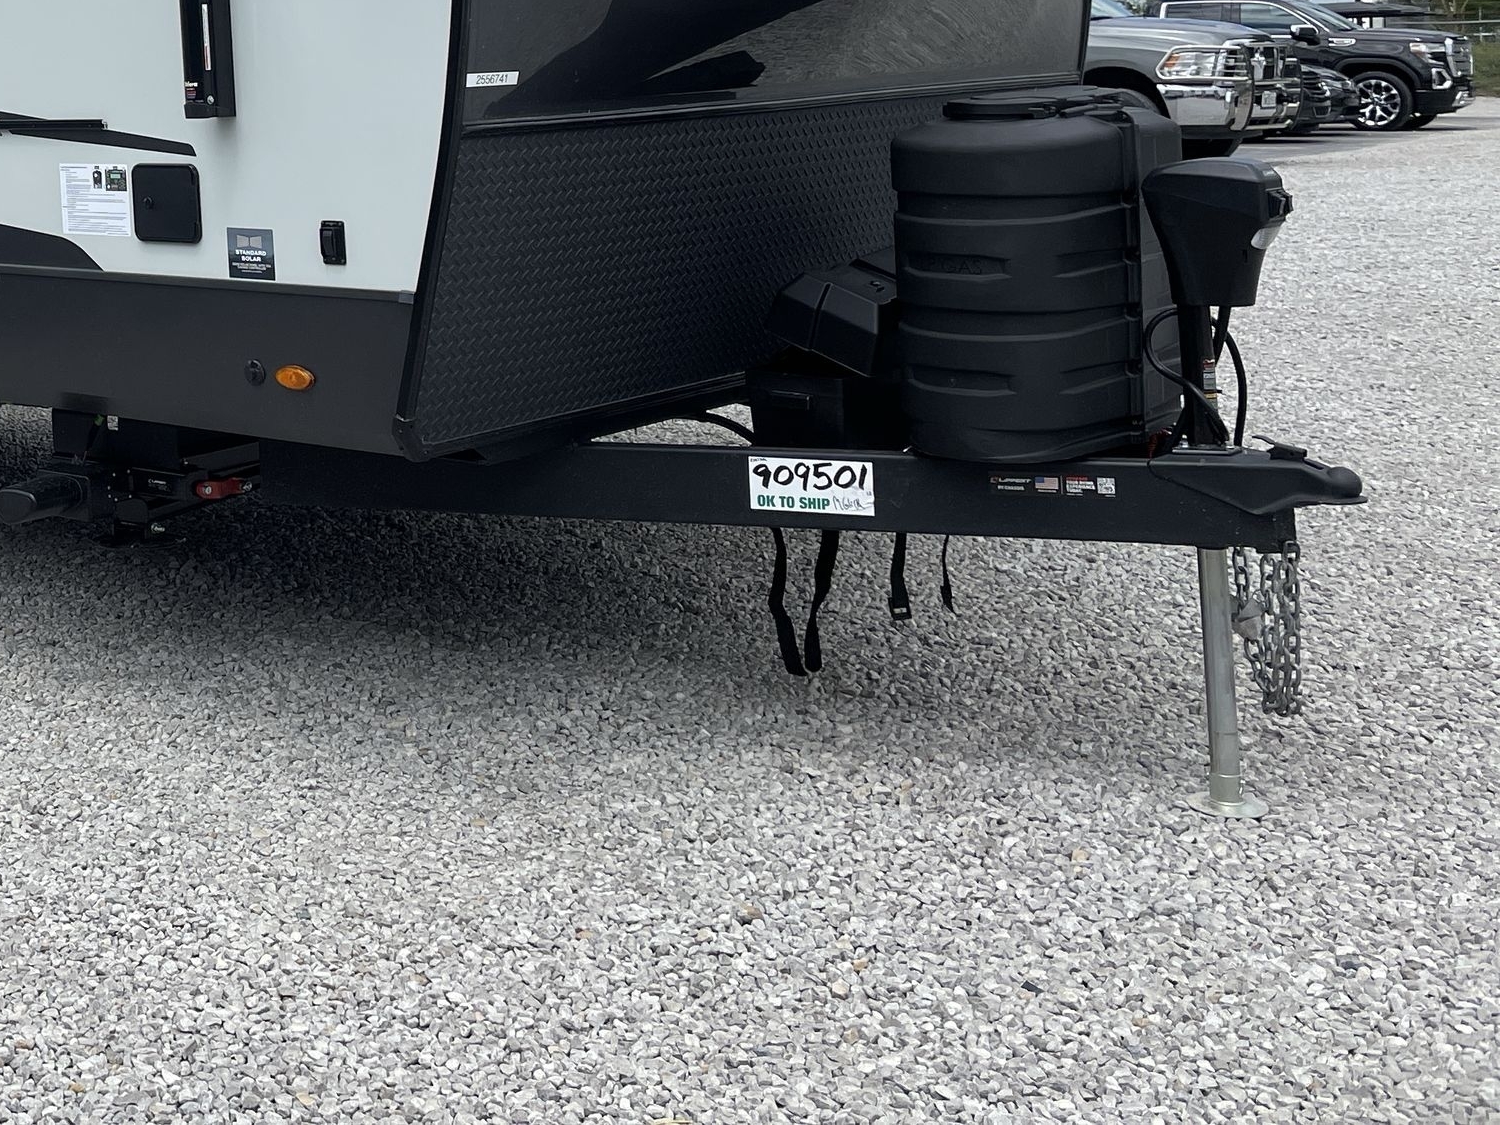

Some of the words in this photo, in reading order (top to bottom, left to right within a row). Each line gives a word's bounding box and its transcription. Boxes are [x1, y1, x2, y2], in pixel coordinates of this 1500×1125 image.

[752, 462, 868, 492] 909501
[757, 494, 776, 508] OK
[779, 496, 795, 509] TO
[799, 497, 831, 510] SHIP
